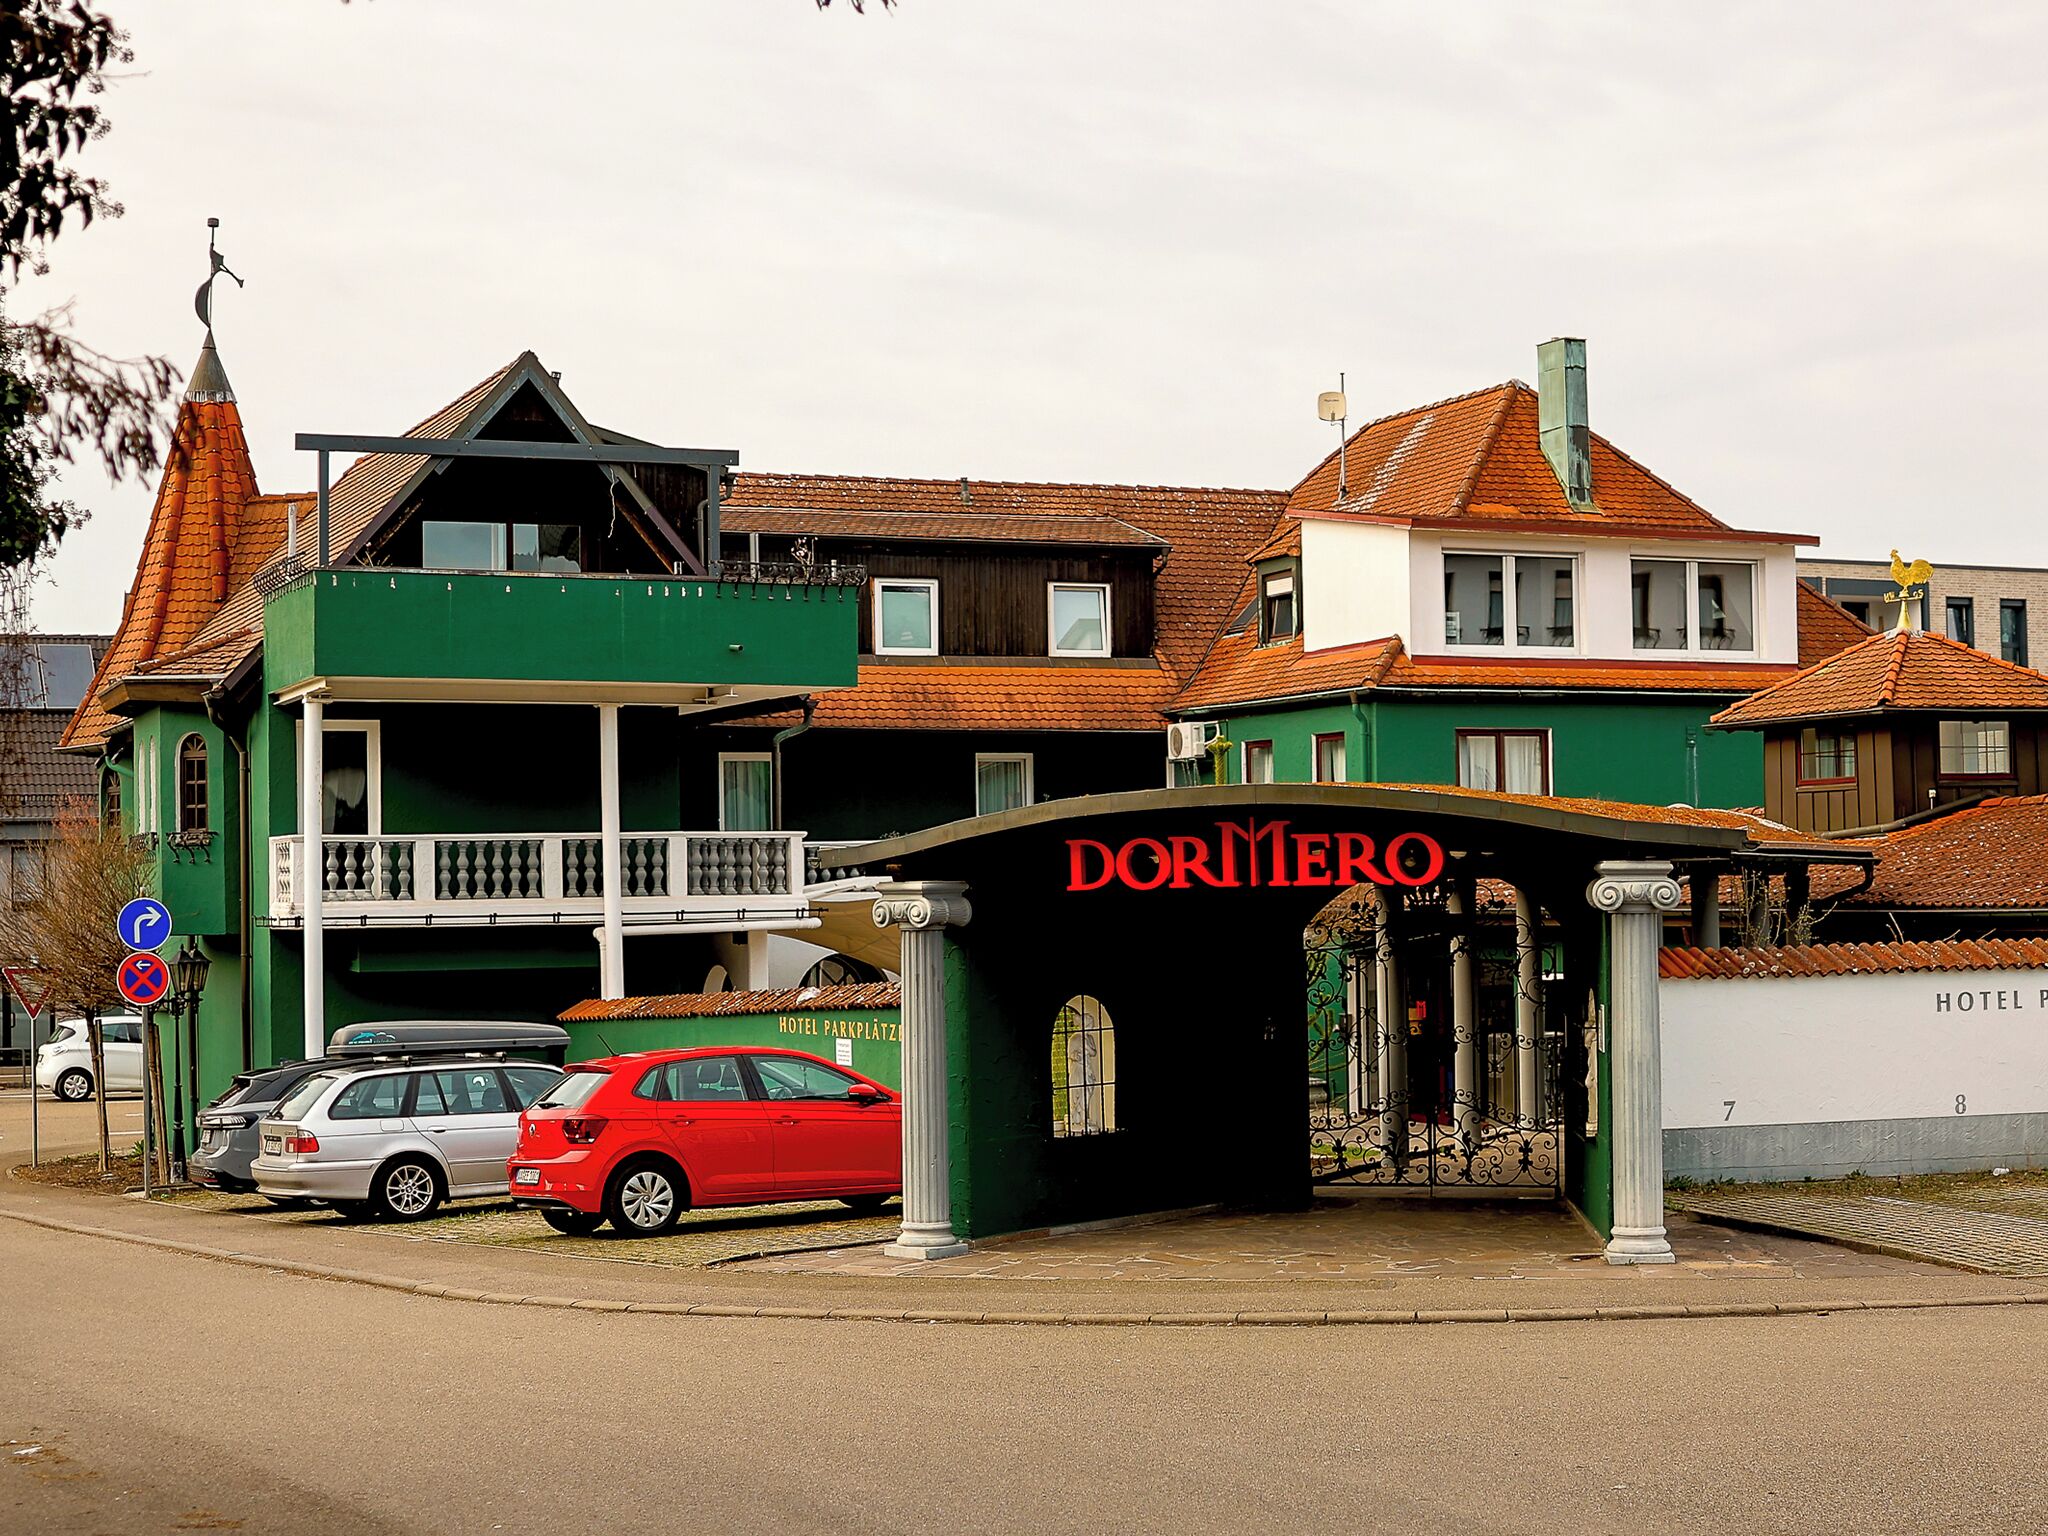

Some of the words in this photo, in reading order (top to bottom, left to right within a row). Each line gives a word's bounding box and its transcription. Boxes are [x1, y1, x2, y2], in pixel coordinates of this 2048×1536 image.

[1065, 816, 1445, 891] DORMERO
[1936, 990, 2023, 1012] HOTEL
[779, 1016, 818, 1036] HOTEL
[1723, 1100, 1736, 1121] 7
[1954, 1094, 1967, 1115] 8
